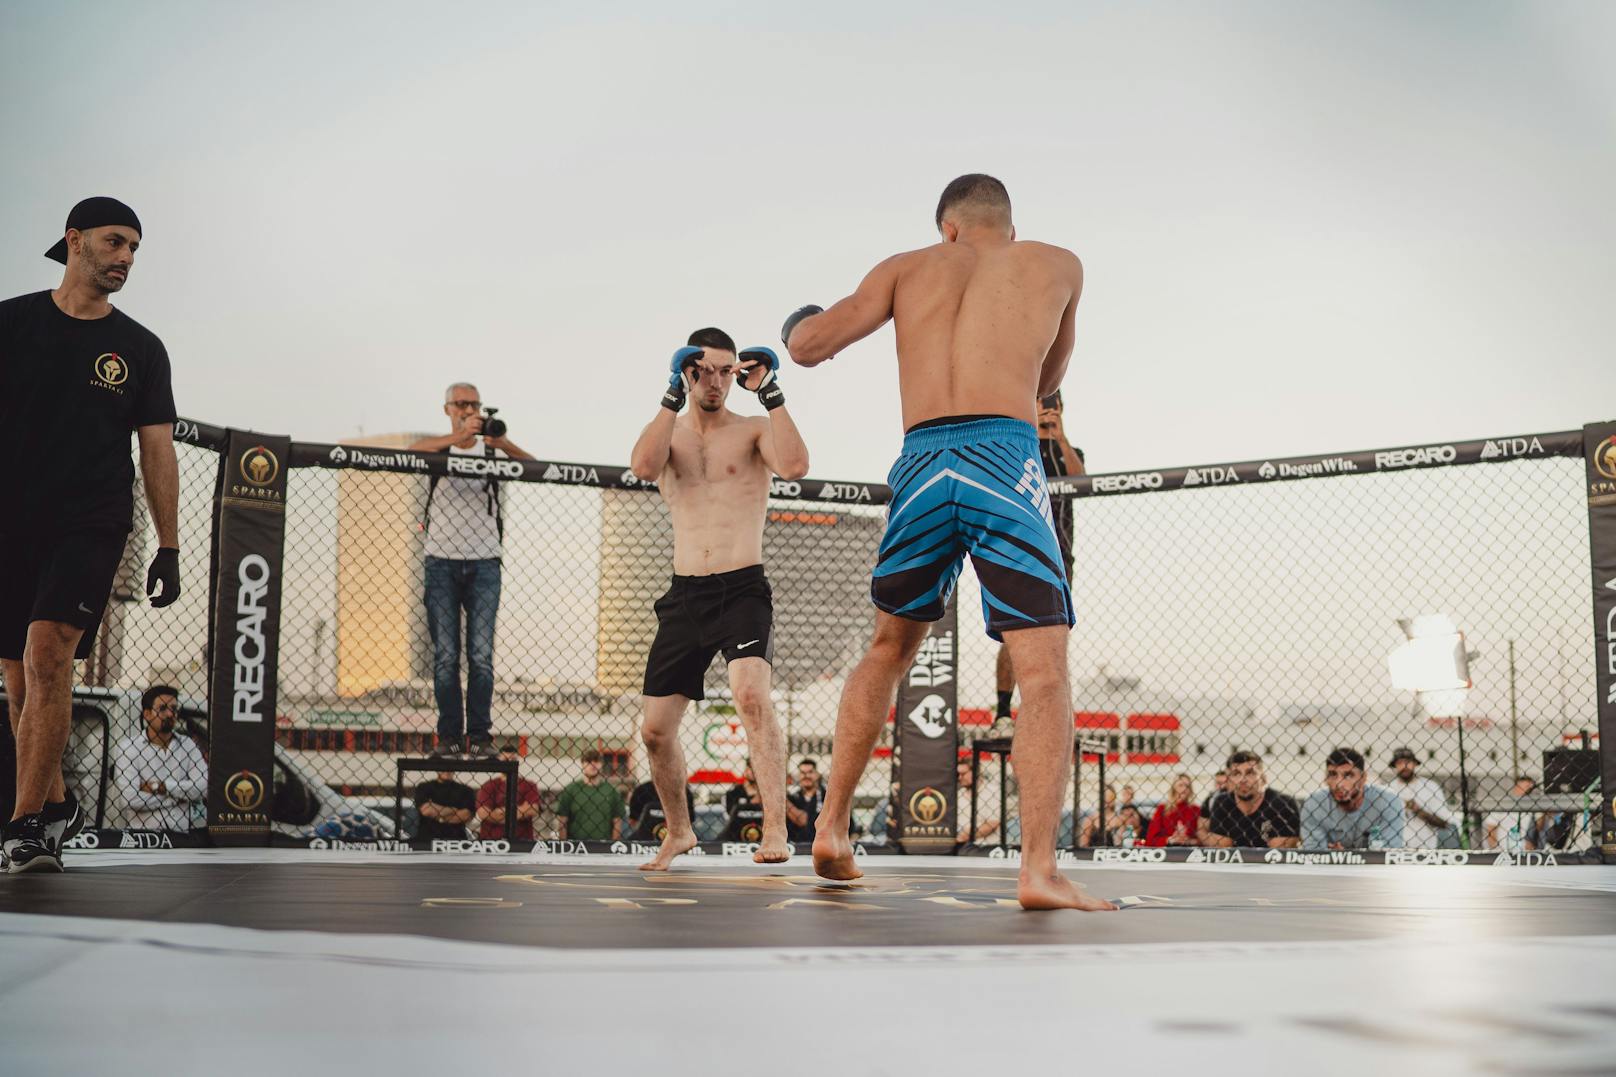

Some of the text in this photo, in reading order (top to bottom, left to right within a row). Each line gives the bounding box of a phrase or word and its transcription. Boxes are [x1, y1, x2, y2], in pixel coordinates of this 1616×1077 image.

[175, 420, 200, 441] DA
[1498, 436, 1545, 457] TDA
[1375, 445, 1457, 468] RECARO
[447, 457, 524, 477] RECARO
[559, 464, 600, 483] TDA
[1199, 466, 1239, 484] TDA
[1092, 472, 1164, 493] RECARO
[232, 485, 281, 499] SPARTA
[835, 484, 872, 501] TDA
[233, 554, 270, 722] RECARO
[218, 813, 269, 823] SPARTA
[904, 826, 950, 836] SPARTA
[133, 832, 173, 849] TDA
[432, 840, 511, 854] RECARO
[549, 840, 589, 856] TDA
[1093, 848, 1167, 863] RECARO
[1203, 849, 1244, 863] TDA
[1385, 851, 1468, 865] RECARO
[1515, 851, 1559, 867] TDA
